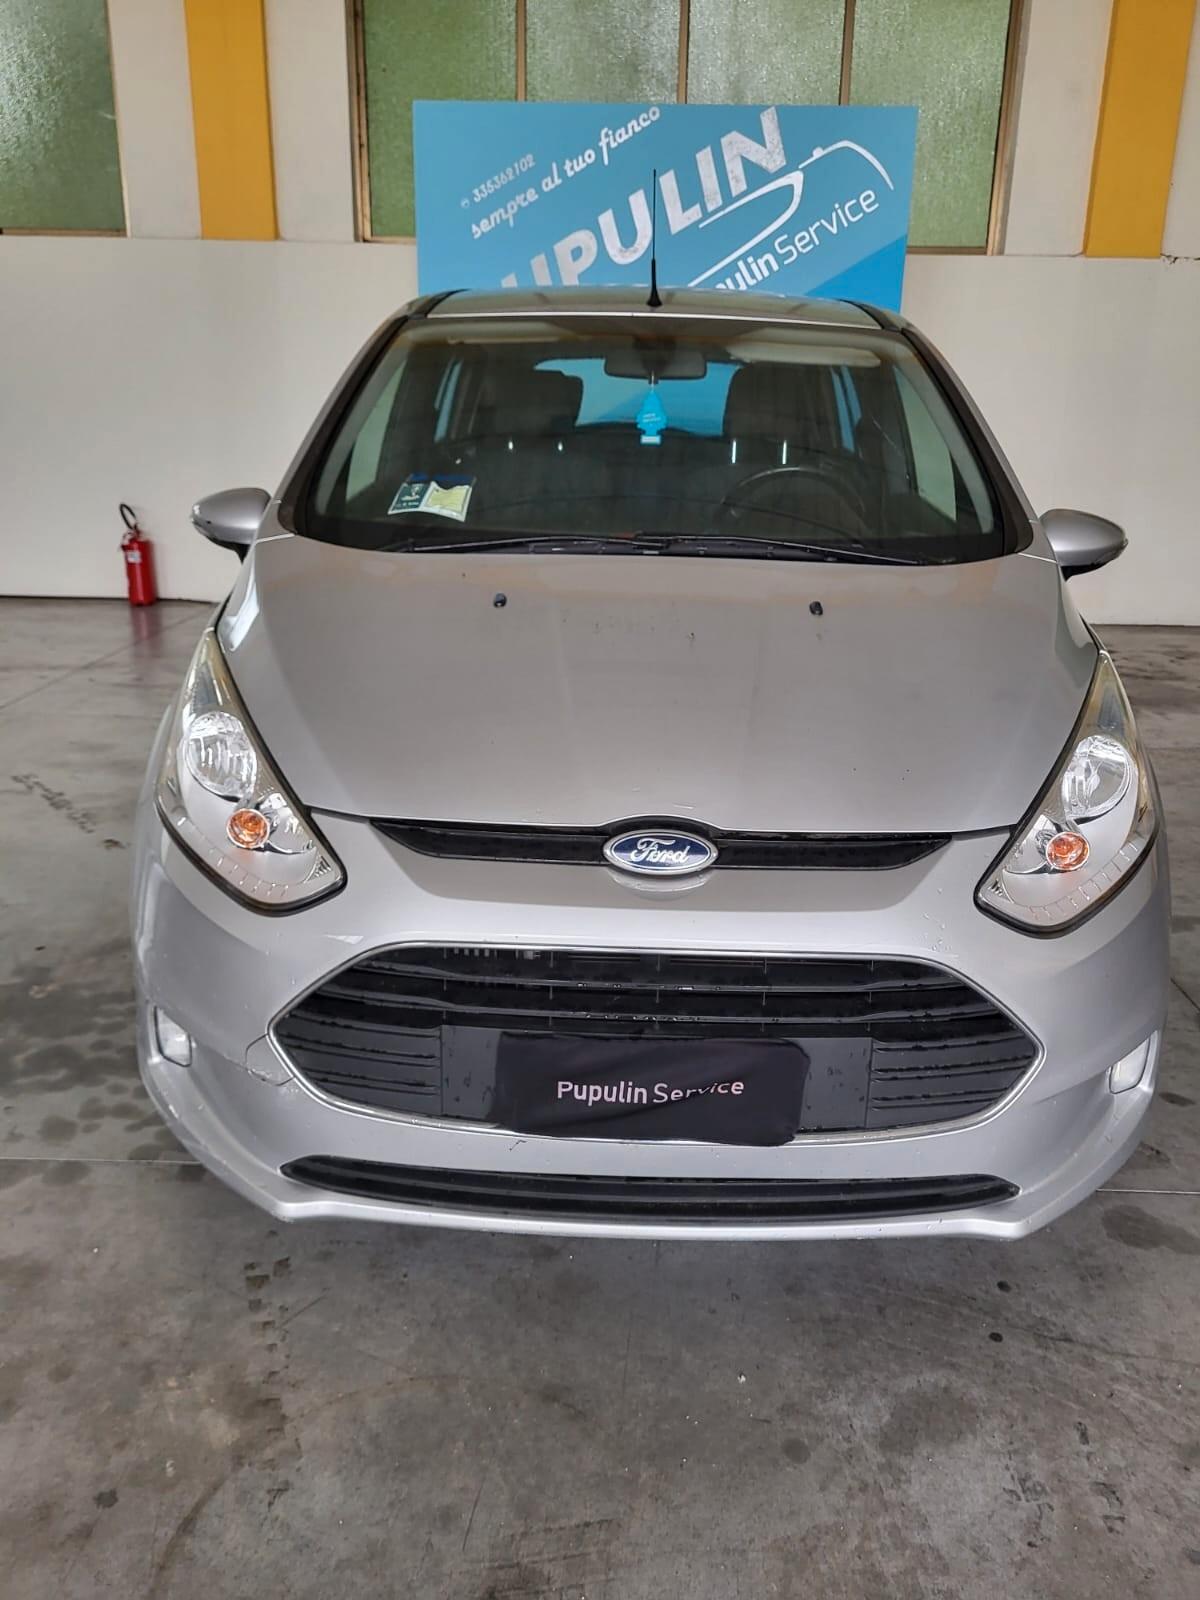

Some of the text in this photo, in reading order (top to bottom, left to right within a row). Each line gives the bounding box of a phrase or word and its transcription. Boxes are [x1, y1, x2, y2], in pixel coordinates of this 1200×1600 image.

[471, 106, 660, 239] sempre al tuo fianco
[715, 189, 879, 290] ulin Service
[630, 838, 690, 862] Ford
[557, 1080, 745, 1106] Pupulin Service
